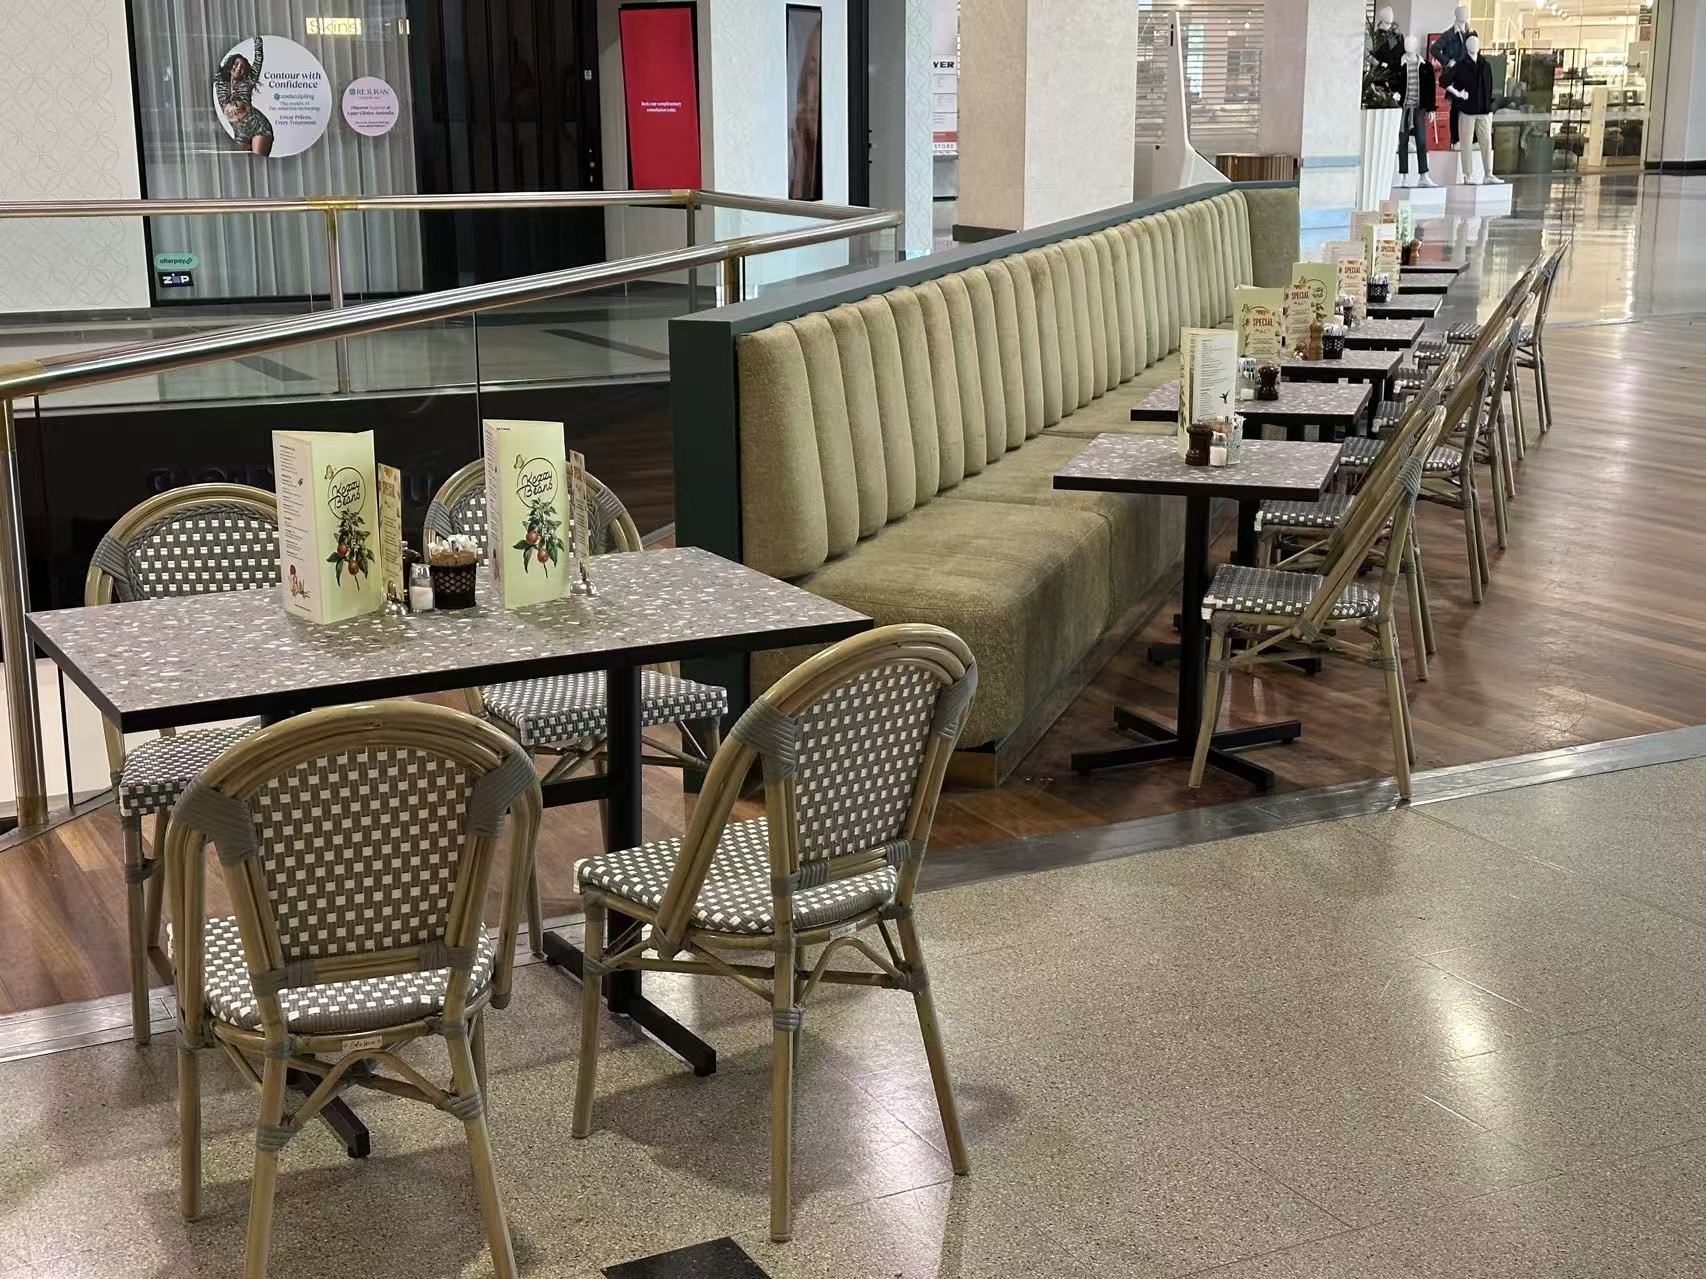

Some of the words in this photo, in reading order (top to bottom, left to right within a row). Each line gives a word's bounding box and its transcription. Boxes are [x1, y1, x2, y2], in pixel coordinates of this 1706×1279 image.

[263, 71, 300, 80] Contour
[301, 71, 321, 80] with
[268, 80, 319, 89] Confidence
[1252, 317, 1274, 327] SPECIAL
